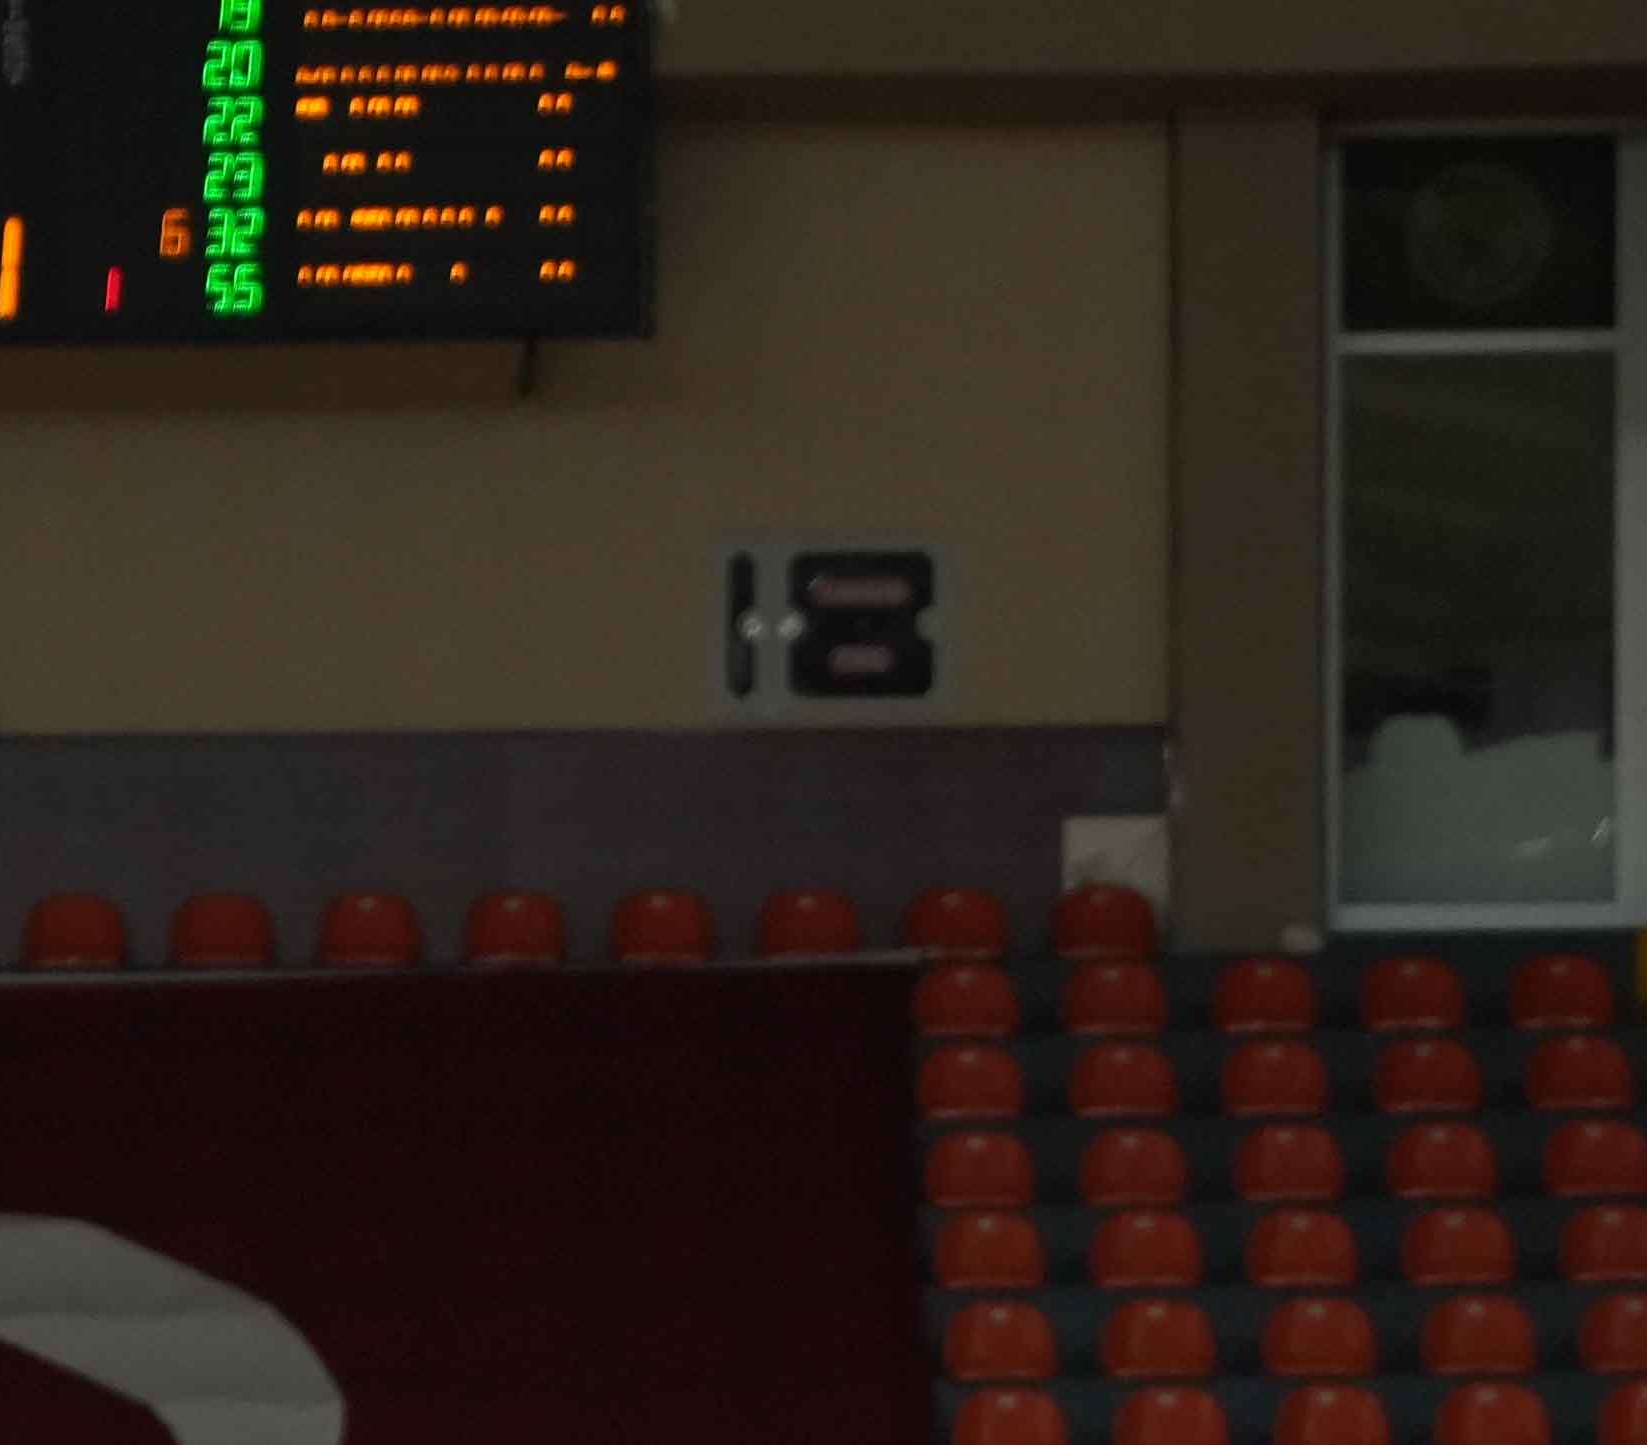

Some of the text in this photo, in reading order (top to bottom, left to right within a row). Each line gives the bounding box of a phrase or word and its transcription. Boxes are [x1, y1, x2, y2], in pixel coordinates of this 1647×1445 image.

[202, 39, 263, 89] 20
[203, 95, 263, 145] 22
[203, 151, 265, 201] 23
[160, 207, 192, 258] 6
[205, 207, 266, 257] 32
[205, 263, 264, 313] 55
